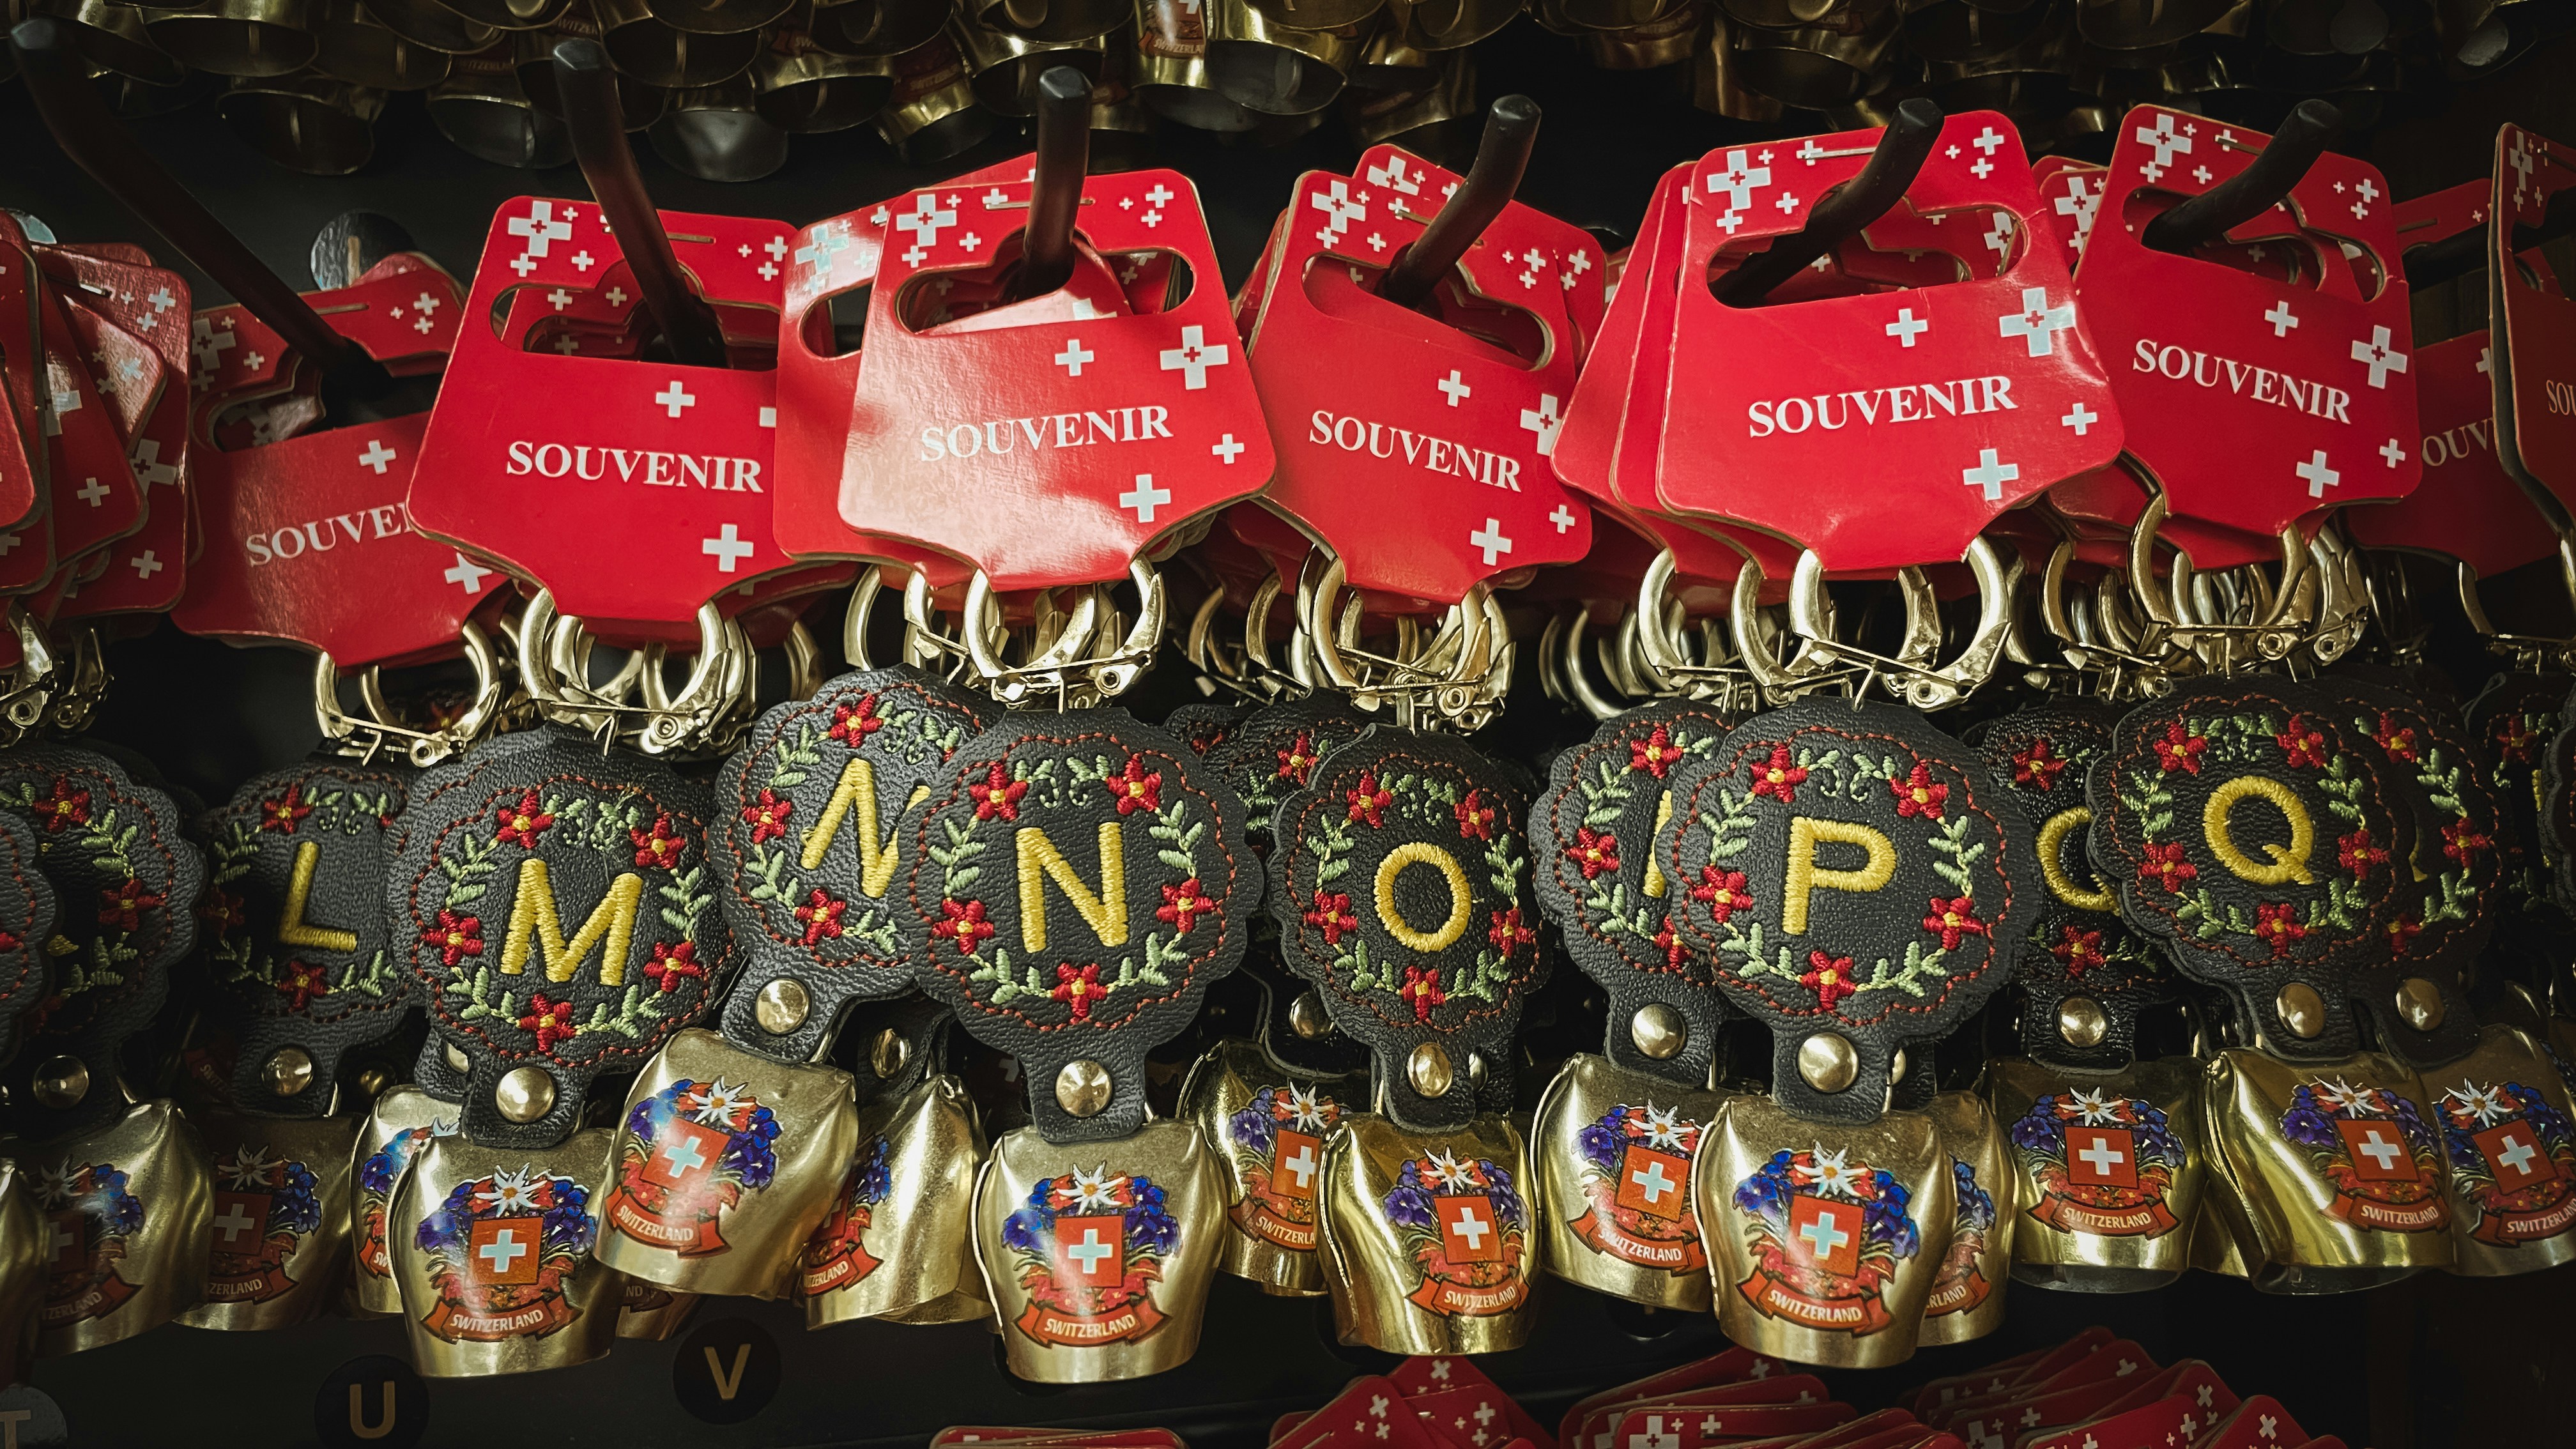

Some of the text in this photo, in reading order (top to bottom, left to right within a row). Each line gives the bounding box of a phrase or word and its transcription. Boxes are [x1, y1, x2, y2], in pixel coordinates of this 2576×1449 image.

[1748, 376, 2019, 438] SOUVENIR
[2133, 339, 2352, 425] SOUVENIR
[920, 406, 1174, 462] SOUVENIR
[1309, 410, 1522, 493] SOUVENIR
[507, 441, 763, 493] SOUVENIR
[2202, 775, 2315, 886] Q
[280, 840, 358, 953] L
[1015, 821, 1129, 953] N
[1373, 841, 1472, 954] O
[1781, 816, 1898, 936] P
[500, 857, 644, 987] M
[617, 1204, 694, 1241] SWITZERLAND
[2062, 1206, 2152, 1229] SWITZERLAND
[2360, 1204, 2439, 1226] SWITZERLAND
[1597, 1228, 1683, 1262] SWITZERLAND
[450, 1309, 544, 1333] SWITZERLAND
[1043, 1314, 1137, 1338] SWITZERLAND
[1444, 1285, 1516, 1309] SWITZERLAND
[1767, 1289, 1863, 1323] SWITZERLAND
[703, 1343, 752, 1401] V
[348, 1380, 397, 1439] U
